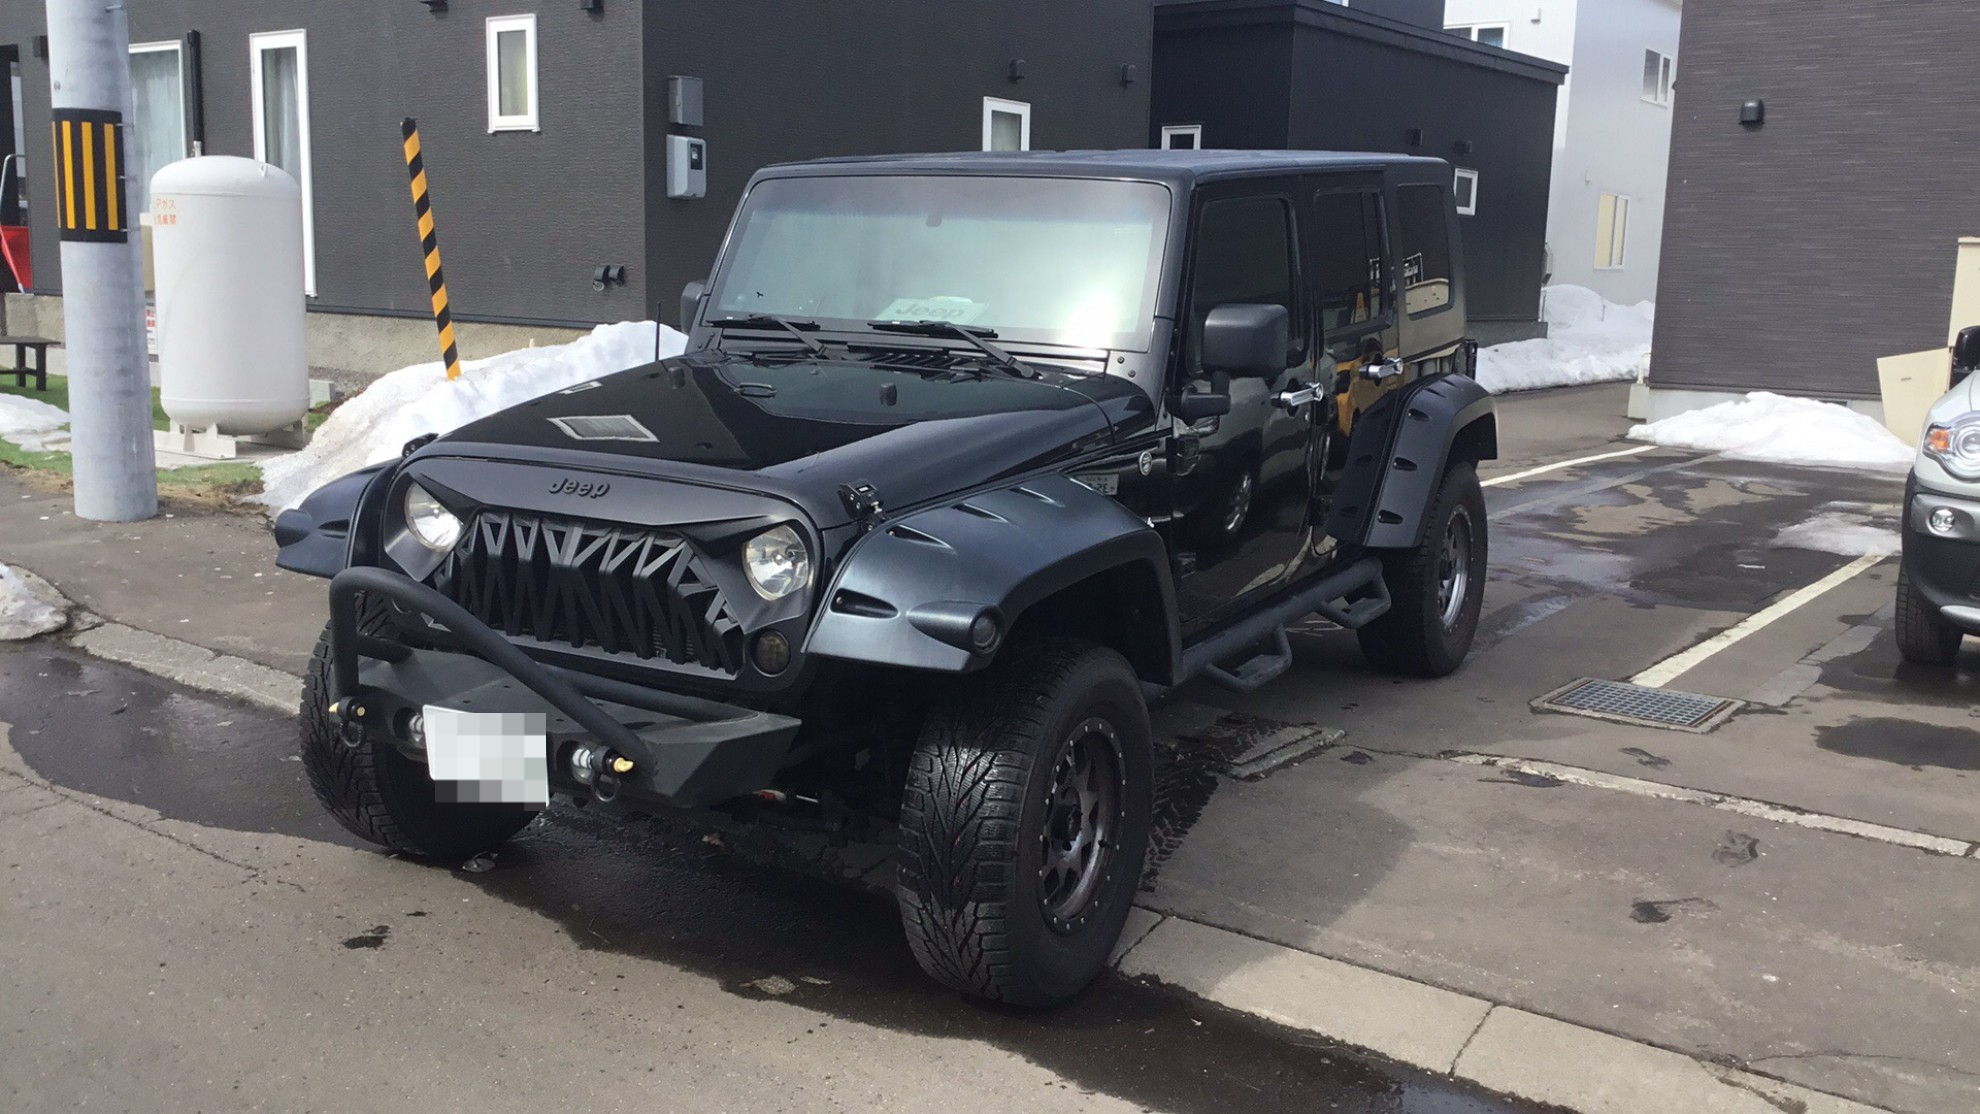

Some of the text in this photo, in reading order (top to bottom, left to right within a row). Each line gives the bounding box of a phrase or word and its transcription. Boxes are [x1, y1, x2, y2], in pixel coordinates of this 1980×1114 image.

[153, 198, 176, 209] Pガス
[895, 303, 965, 319] Jeep
[548, 478, 610, 499] Jeep
